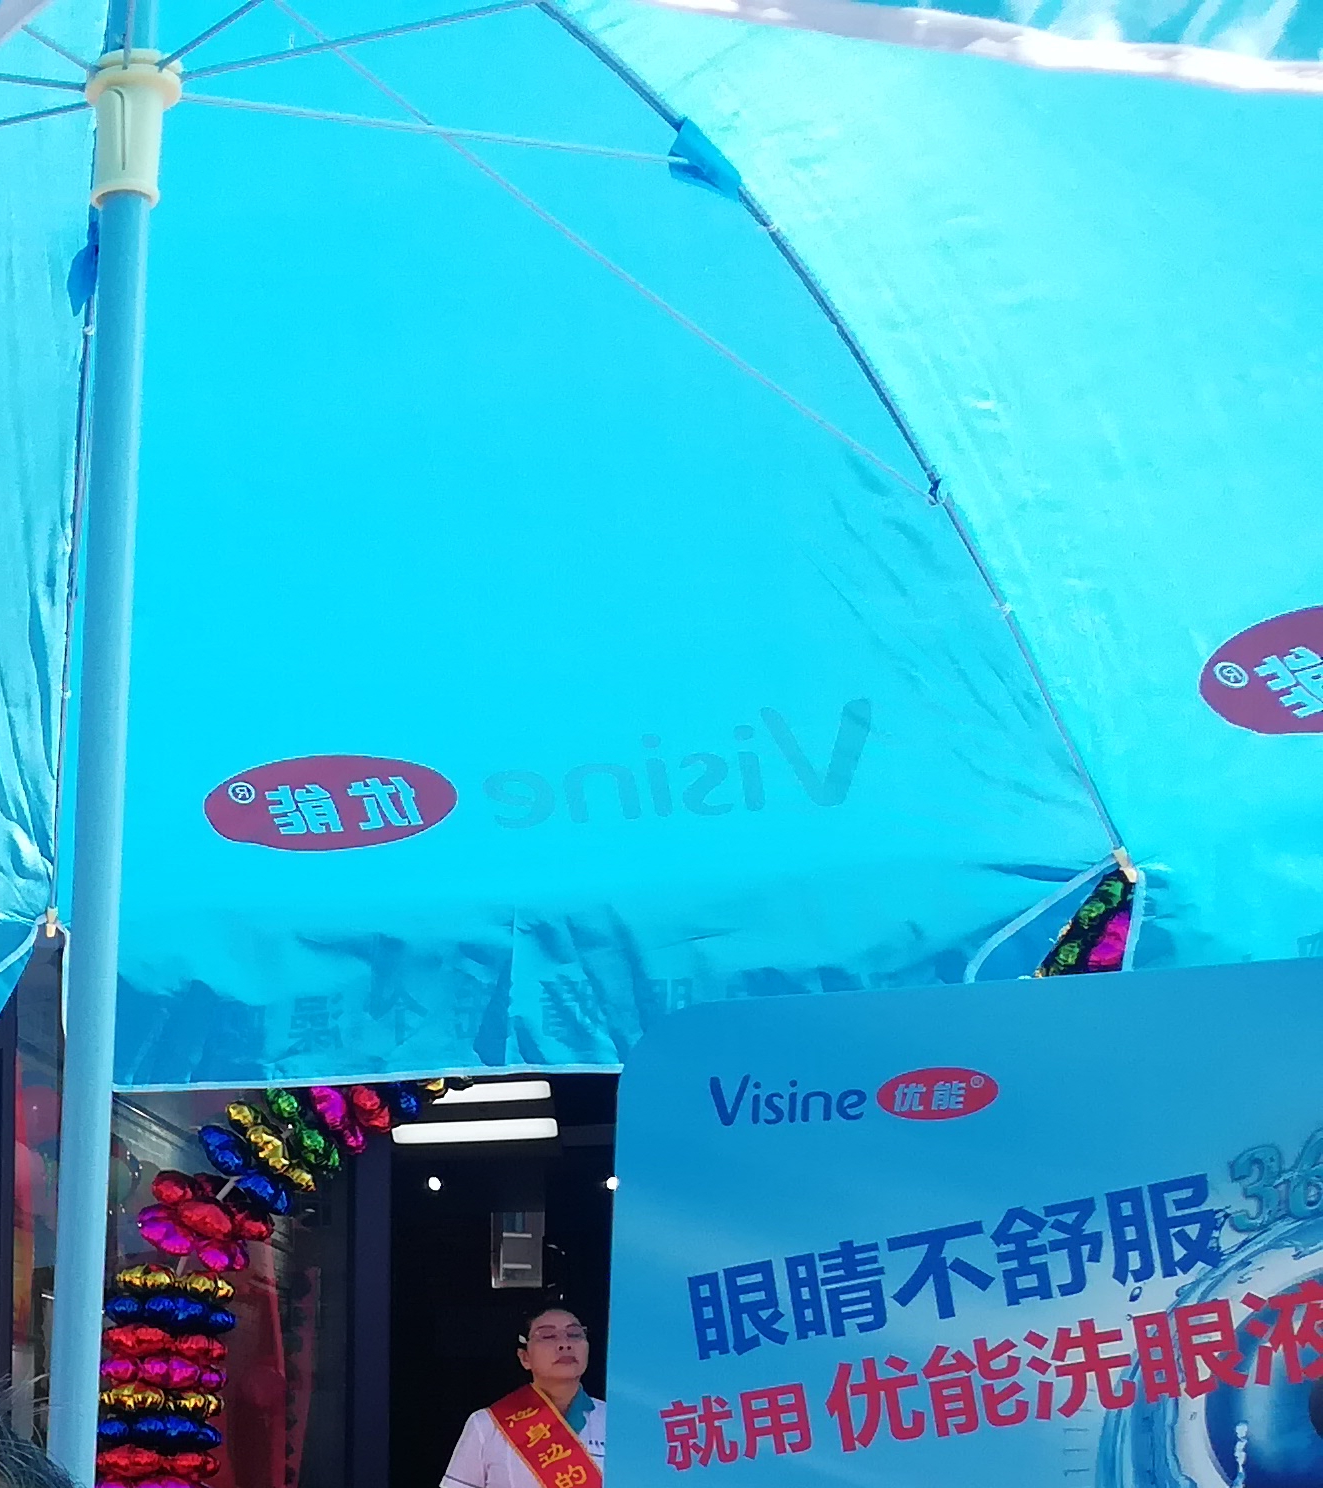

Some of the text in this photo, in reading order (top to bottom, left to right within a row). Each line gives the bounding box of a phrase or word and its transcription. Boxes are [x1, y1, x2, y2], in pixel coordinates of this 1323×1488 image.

[709, 1073, 967, 1127] Visine 优能
[687, 1173, 1223, 1361] 眼睛不舒服
